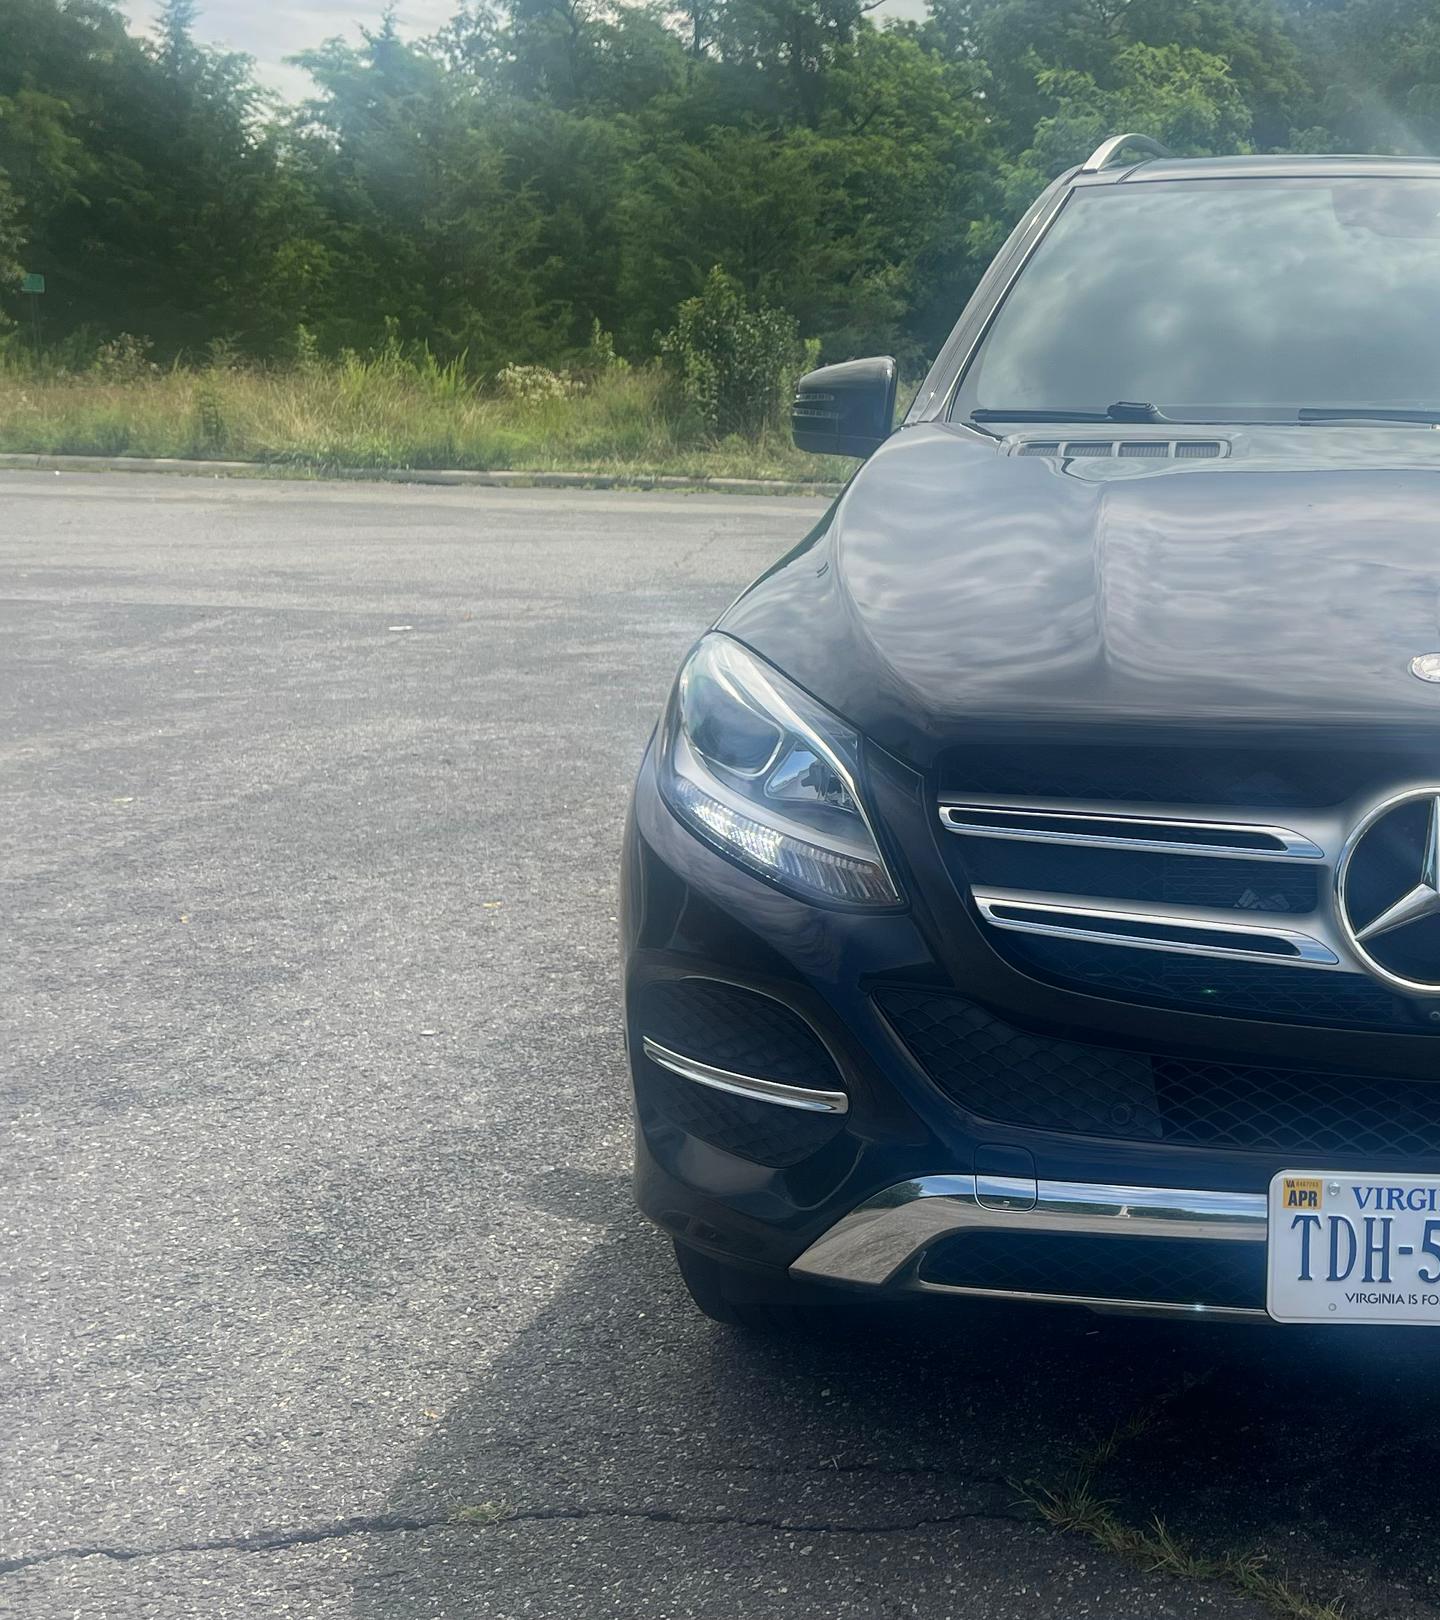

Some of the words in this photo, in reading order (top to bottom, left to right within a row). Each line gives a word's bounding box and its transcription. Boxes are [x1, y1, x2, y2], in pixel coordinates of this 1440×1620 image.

[1286, 1180, 1295, 1188] VA
[1288, 1190, 1317, 1207] APR
[1345, 1293, 1405, 1305] VIRGINIA
[1408, 1294, 1418, 1305] IS
